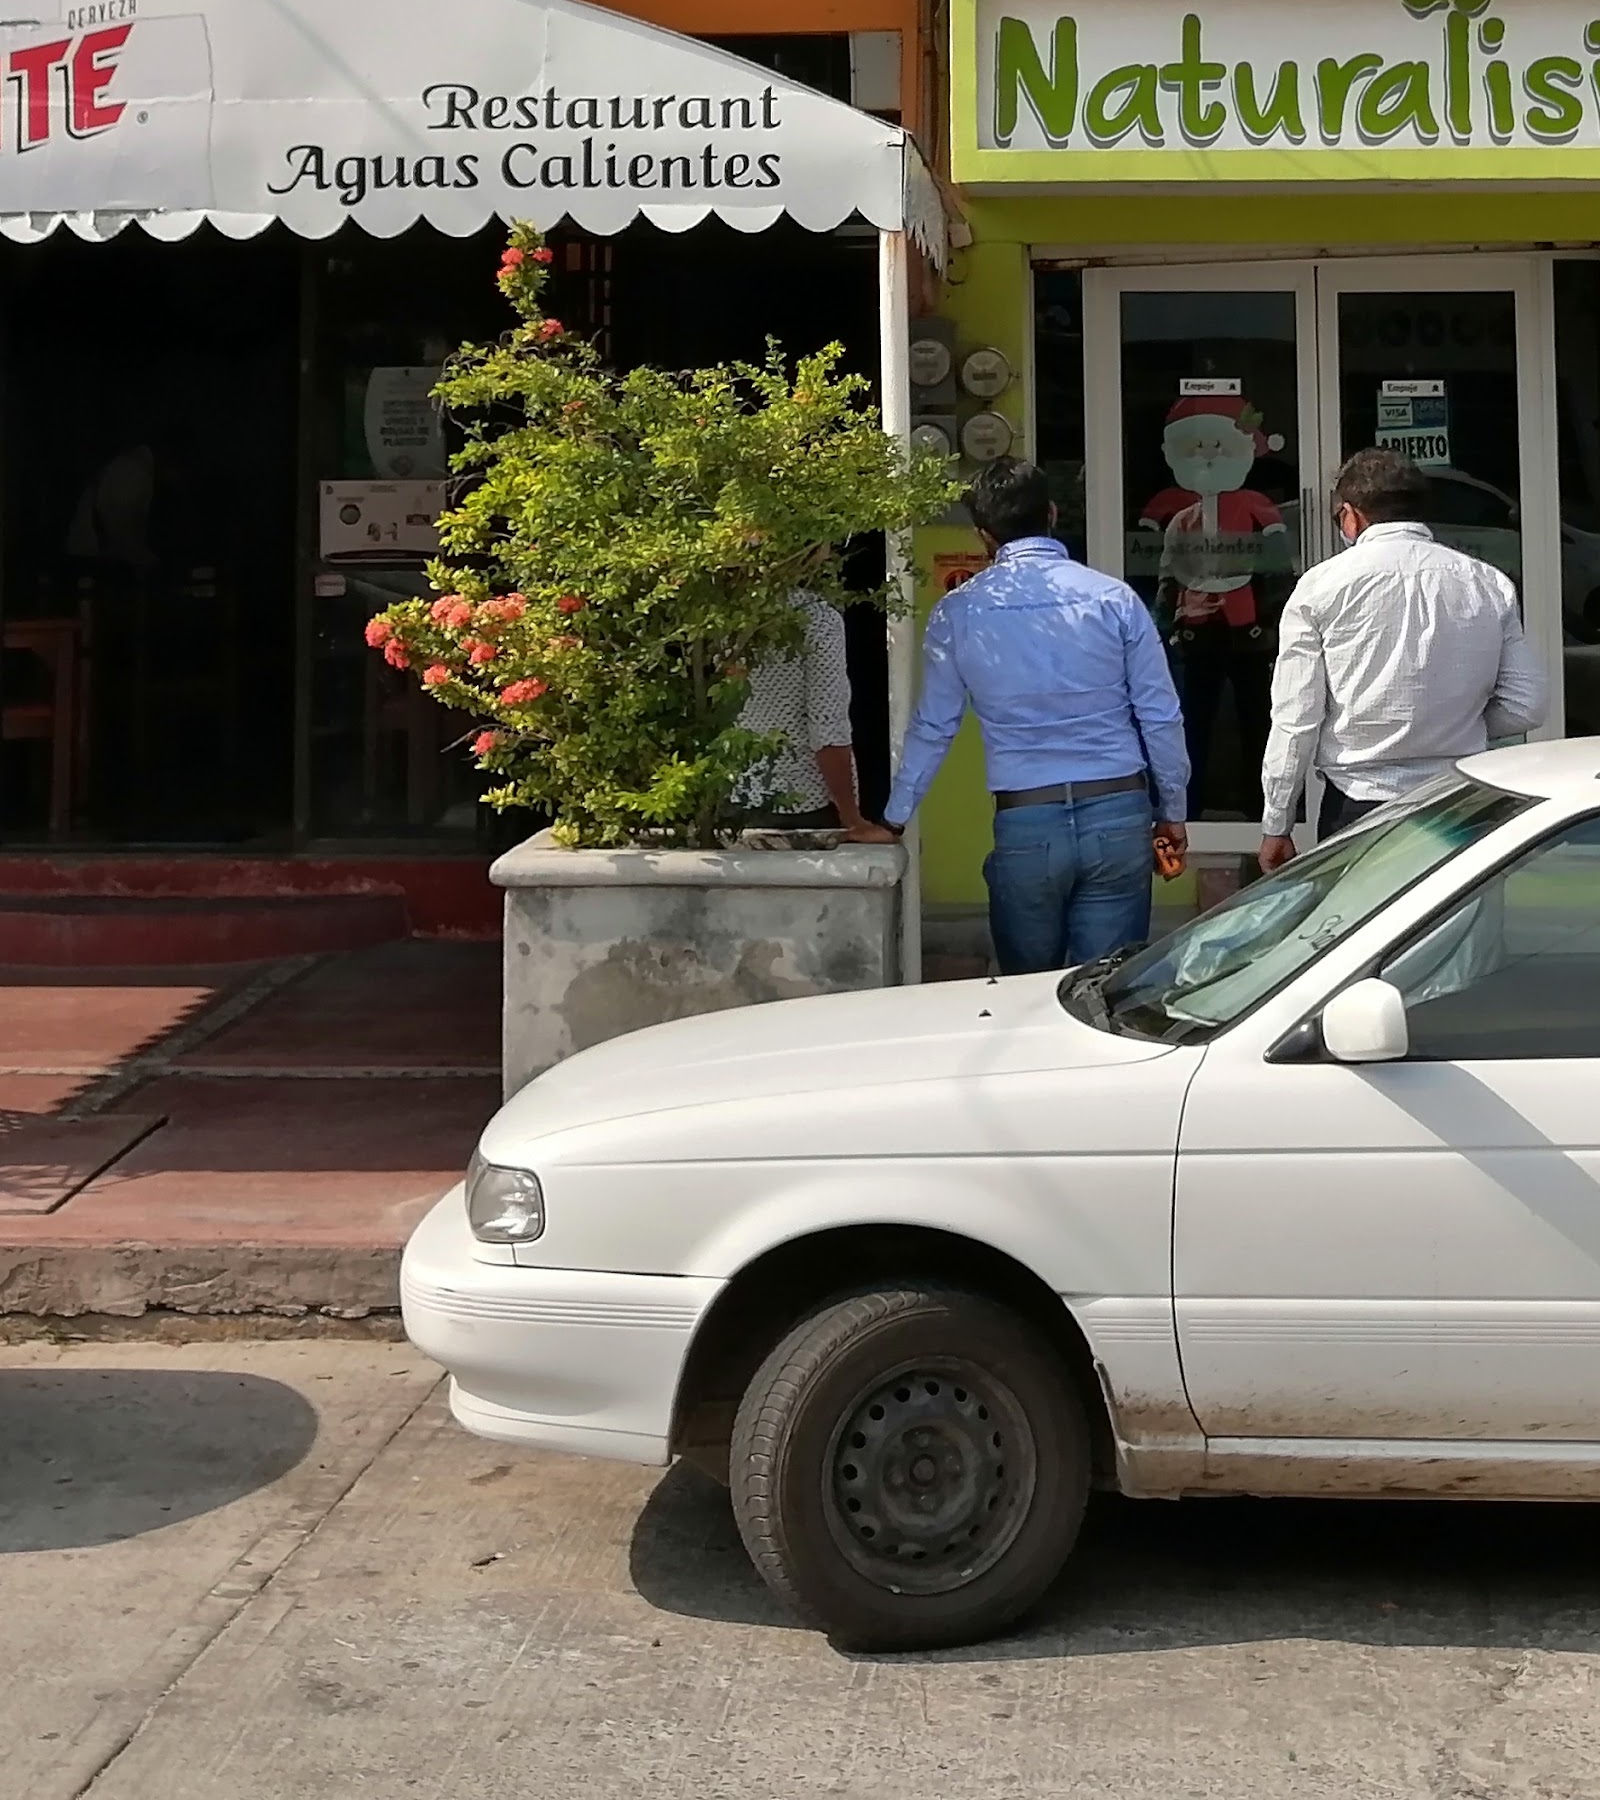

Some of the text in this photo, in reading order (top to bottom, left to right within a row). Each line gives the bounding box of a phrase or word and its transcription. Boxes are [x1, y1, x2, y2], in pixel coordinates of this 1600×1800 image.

[421, 84, 783, 130] Restaurant
[267, 136, 782, 207] Aguas Calientes
[1384, 408, 1407, 418] VISA
